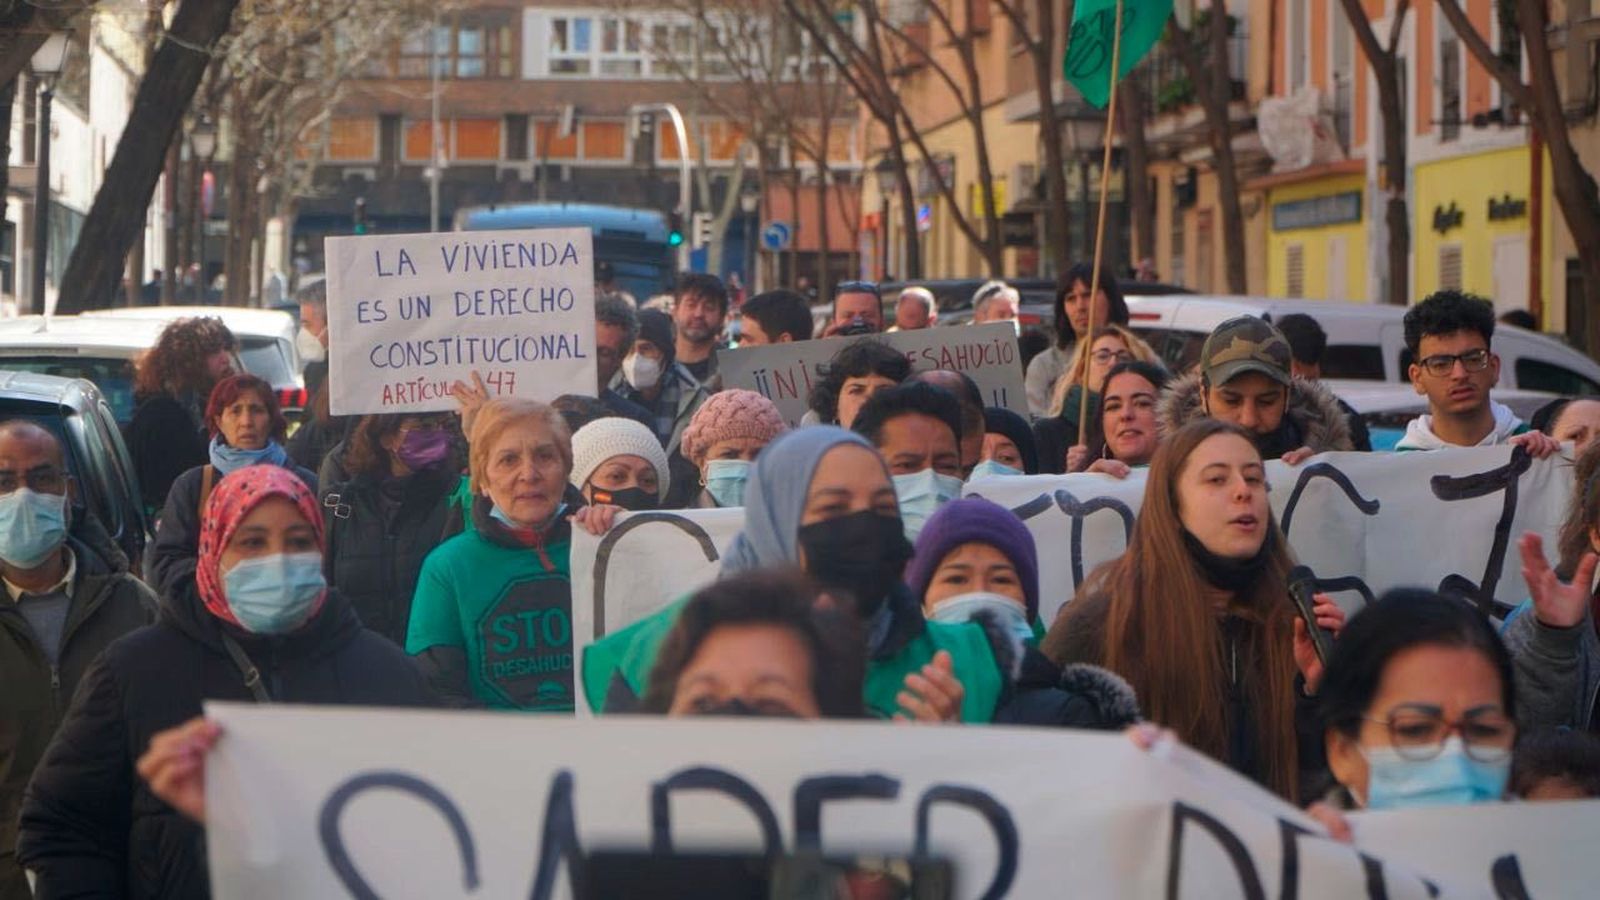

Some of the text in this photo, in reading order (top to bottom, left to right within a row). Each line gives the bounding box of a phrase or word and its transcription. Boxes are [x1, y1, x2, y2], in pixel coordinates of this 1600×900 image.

[375, 240, 579, 278] LA VIVIENDA
[357, 287, 575, 324] ES UN DERECHO
[369, 333, 587, 369] CONSTITUCIONAL
[902, 338, 1014, 373] ESAHUCIO
[382, 371, 516, 406] ARTÍCUL 47
[492, 607, 571, 654] STO
[491, 654, 573, 678] DESAHUC
